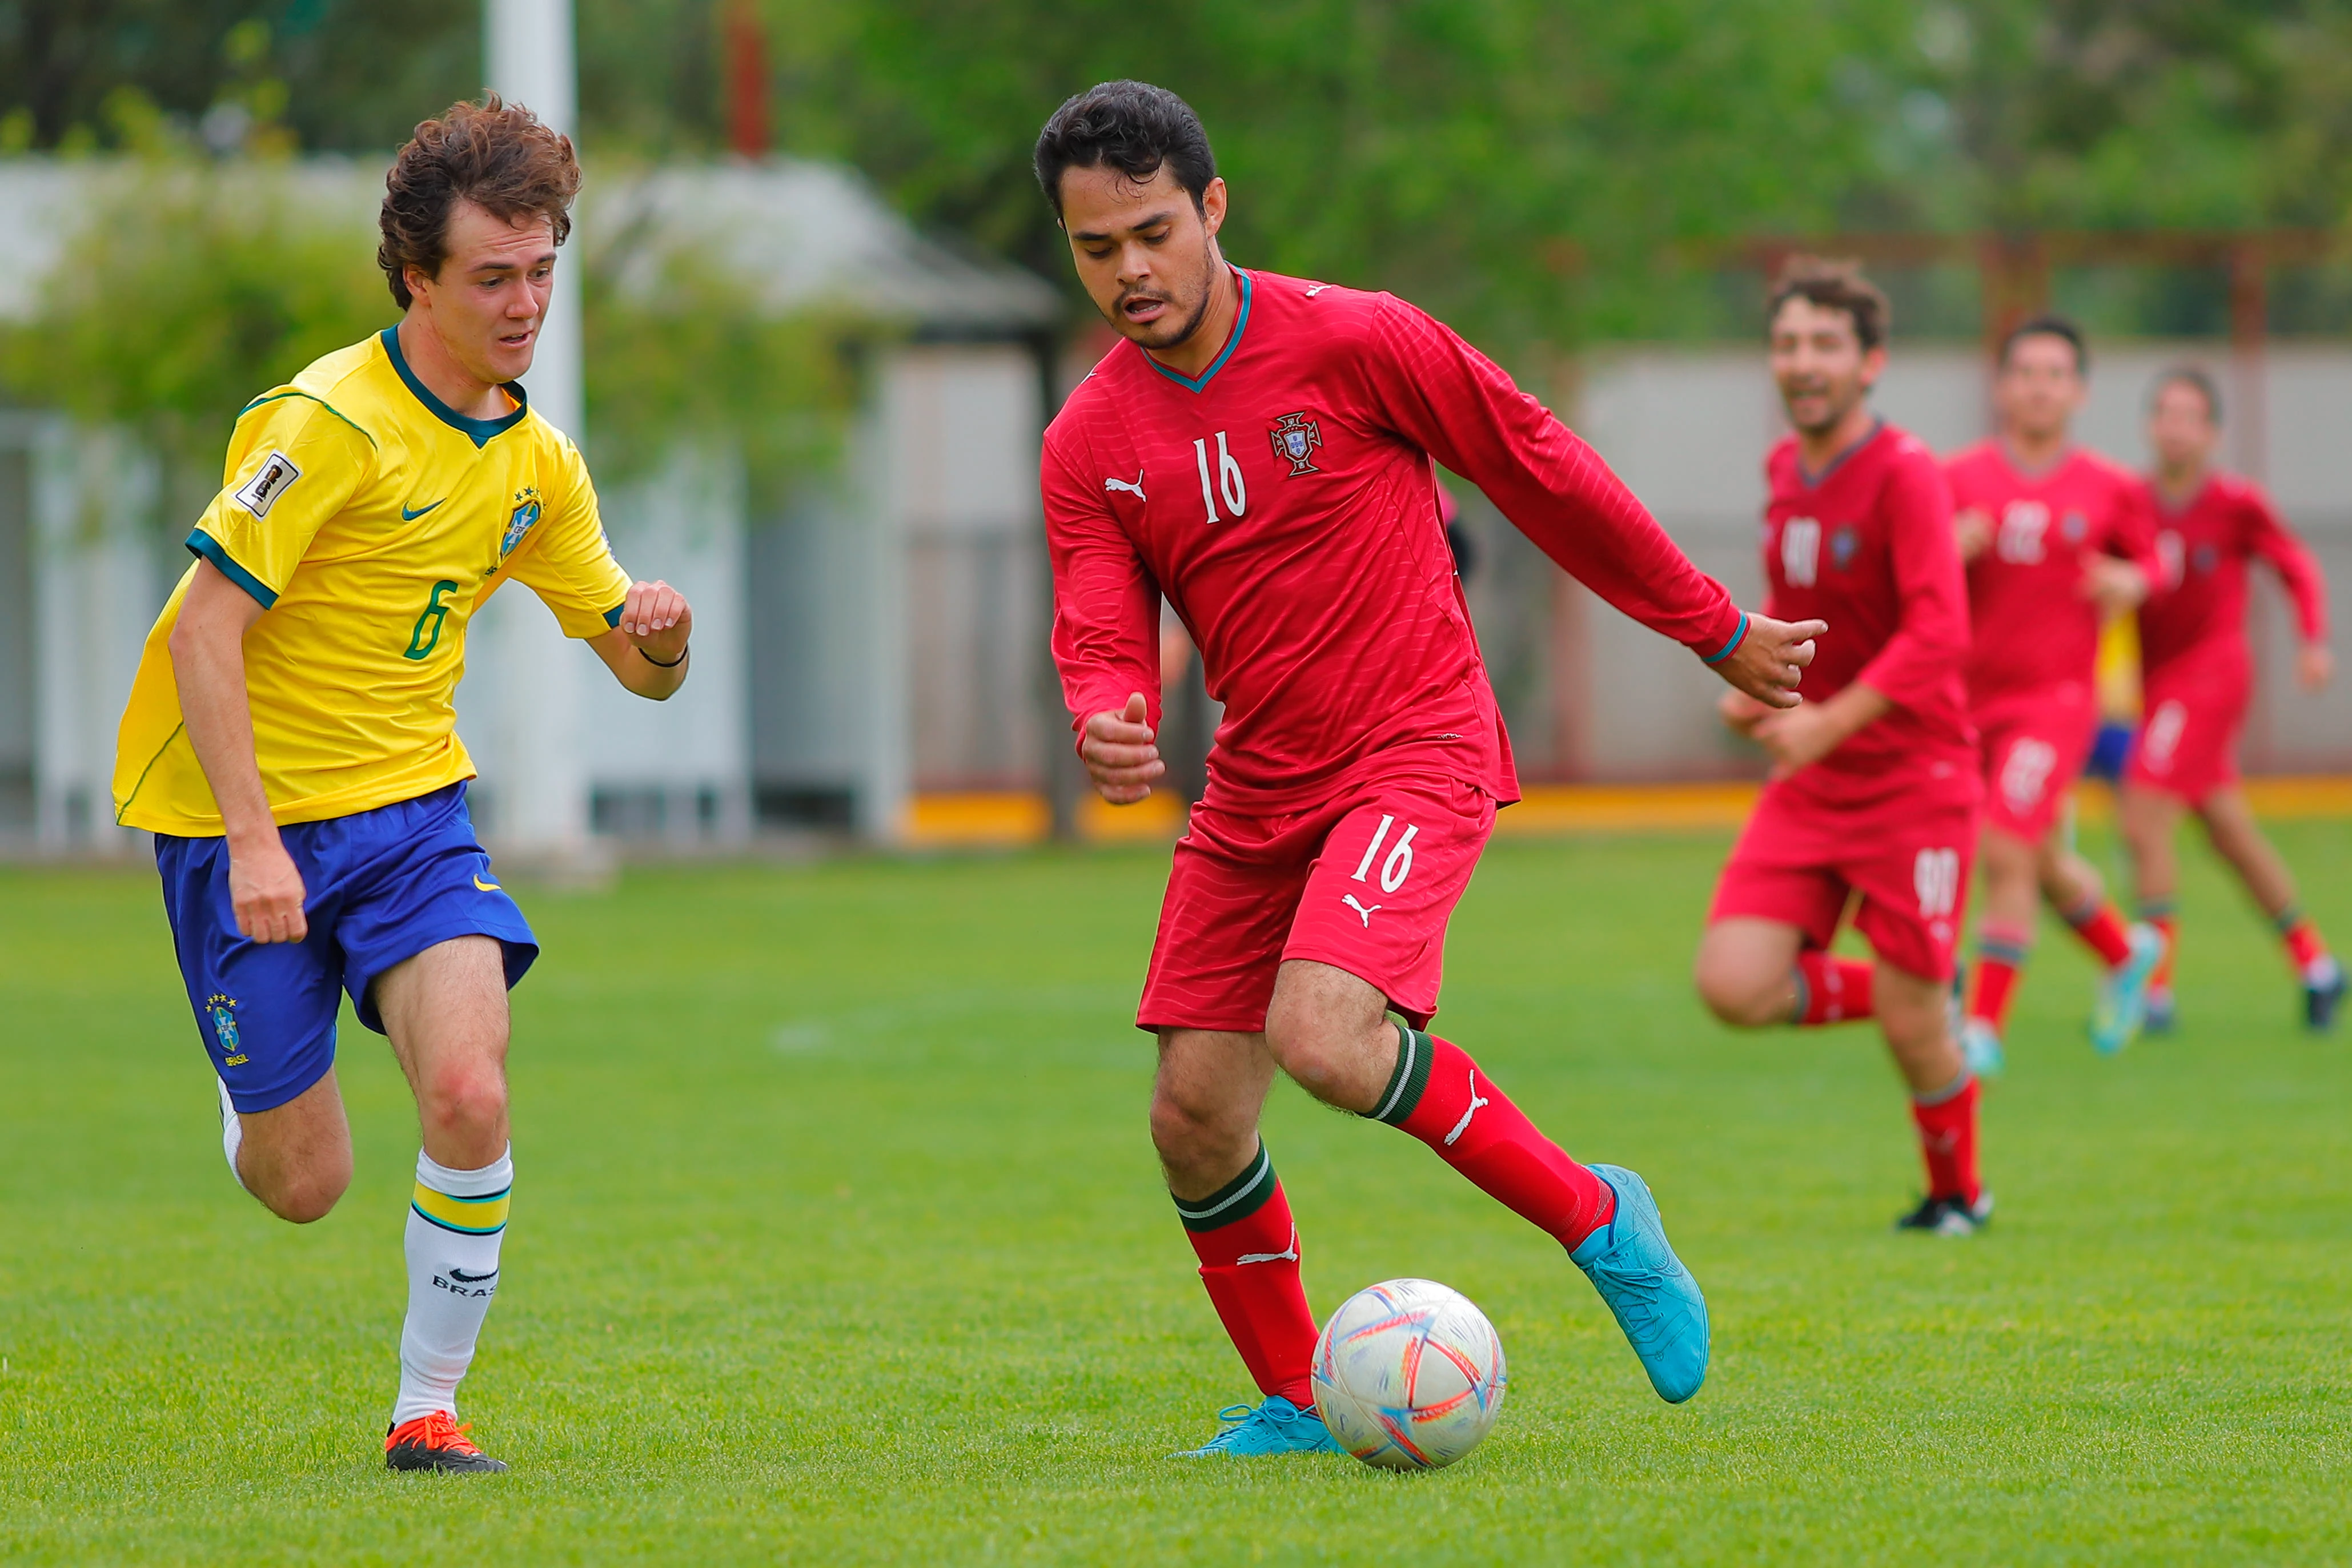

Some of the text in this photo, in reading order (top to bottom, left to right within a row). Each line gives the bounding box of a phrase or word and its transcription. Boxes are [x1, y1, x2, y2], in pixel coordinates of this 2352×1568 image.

[1193, 431, 1246, 524] 16
[403, 580, 459, 660] 6
[1350, 814, 1419, 894] 16
[225, 1054, 250, 1067] BRASIL
